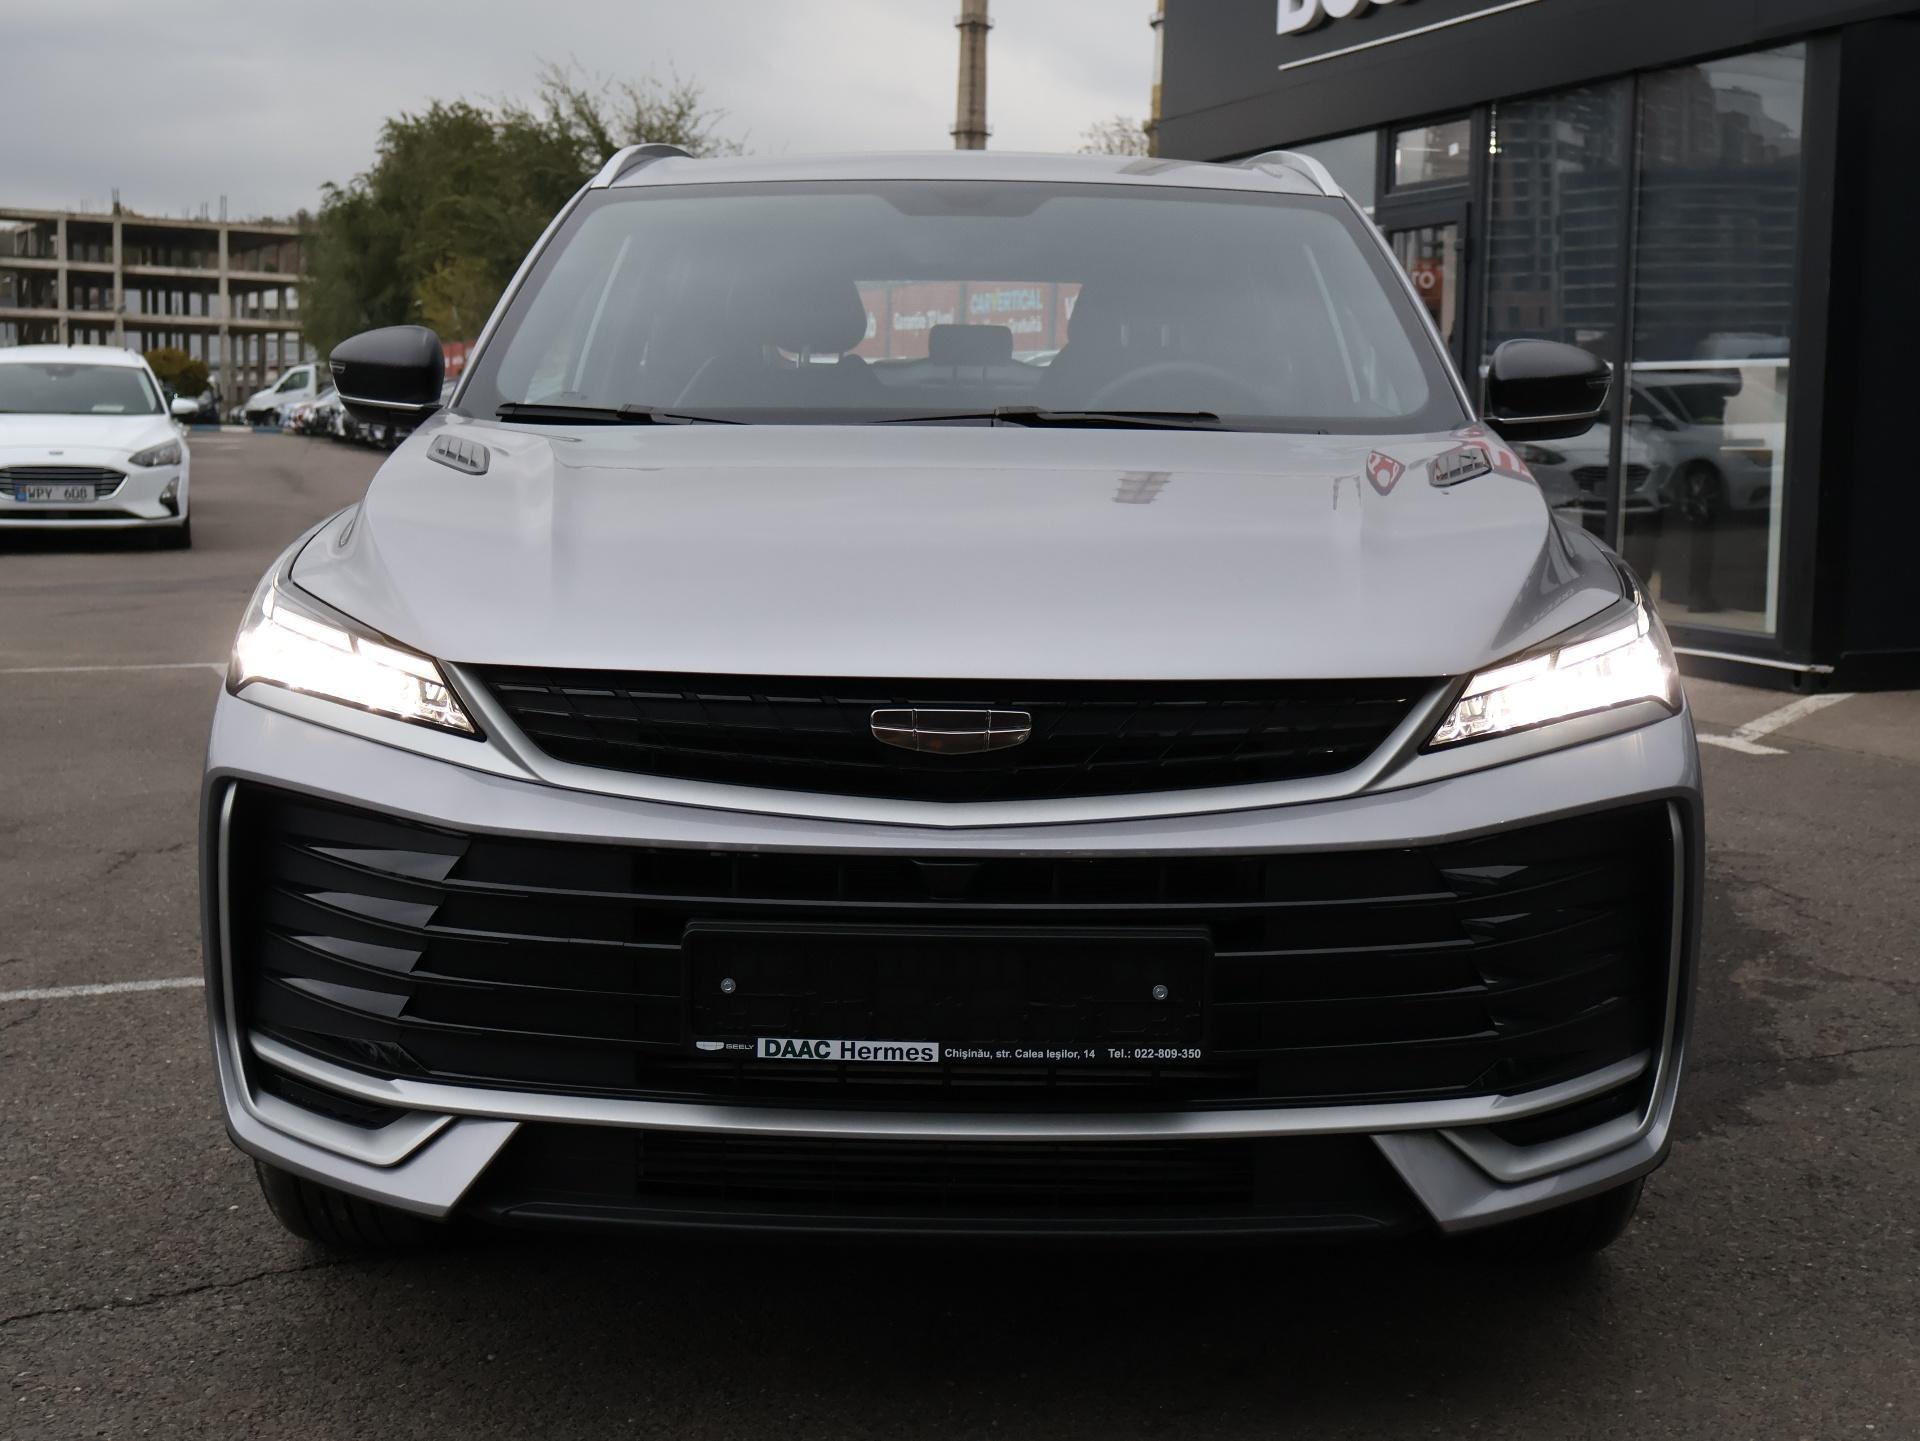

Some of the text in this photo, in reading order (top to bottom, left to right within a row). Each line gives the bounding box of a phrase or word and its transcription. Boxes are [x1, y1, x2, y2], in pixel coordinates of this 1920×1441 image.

[764, 1039, 832, 1059] DAAC
[840, 1041, 934, 1061] Hermes
[995, 1049, 1012, 1059] str.
[1015, 1049, 1044, 1059] Calea
[1083, 1049, 1096, 1059] 14
[1108, 1049, 1131, 1059] Tel.:
[1134, 1049, 1201, 1059] 022-809-350
